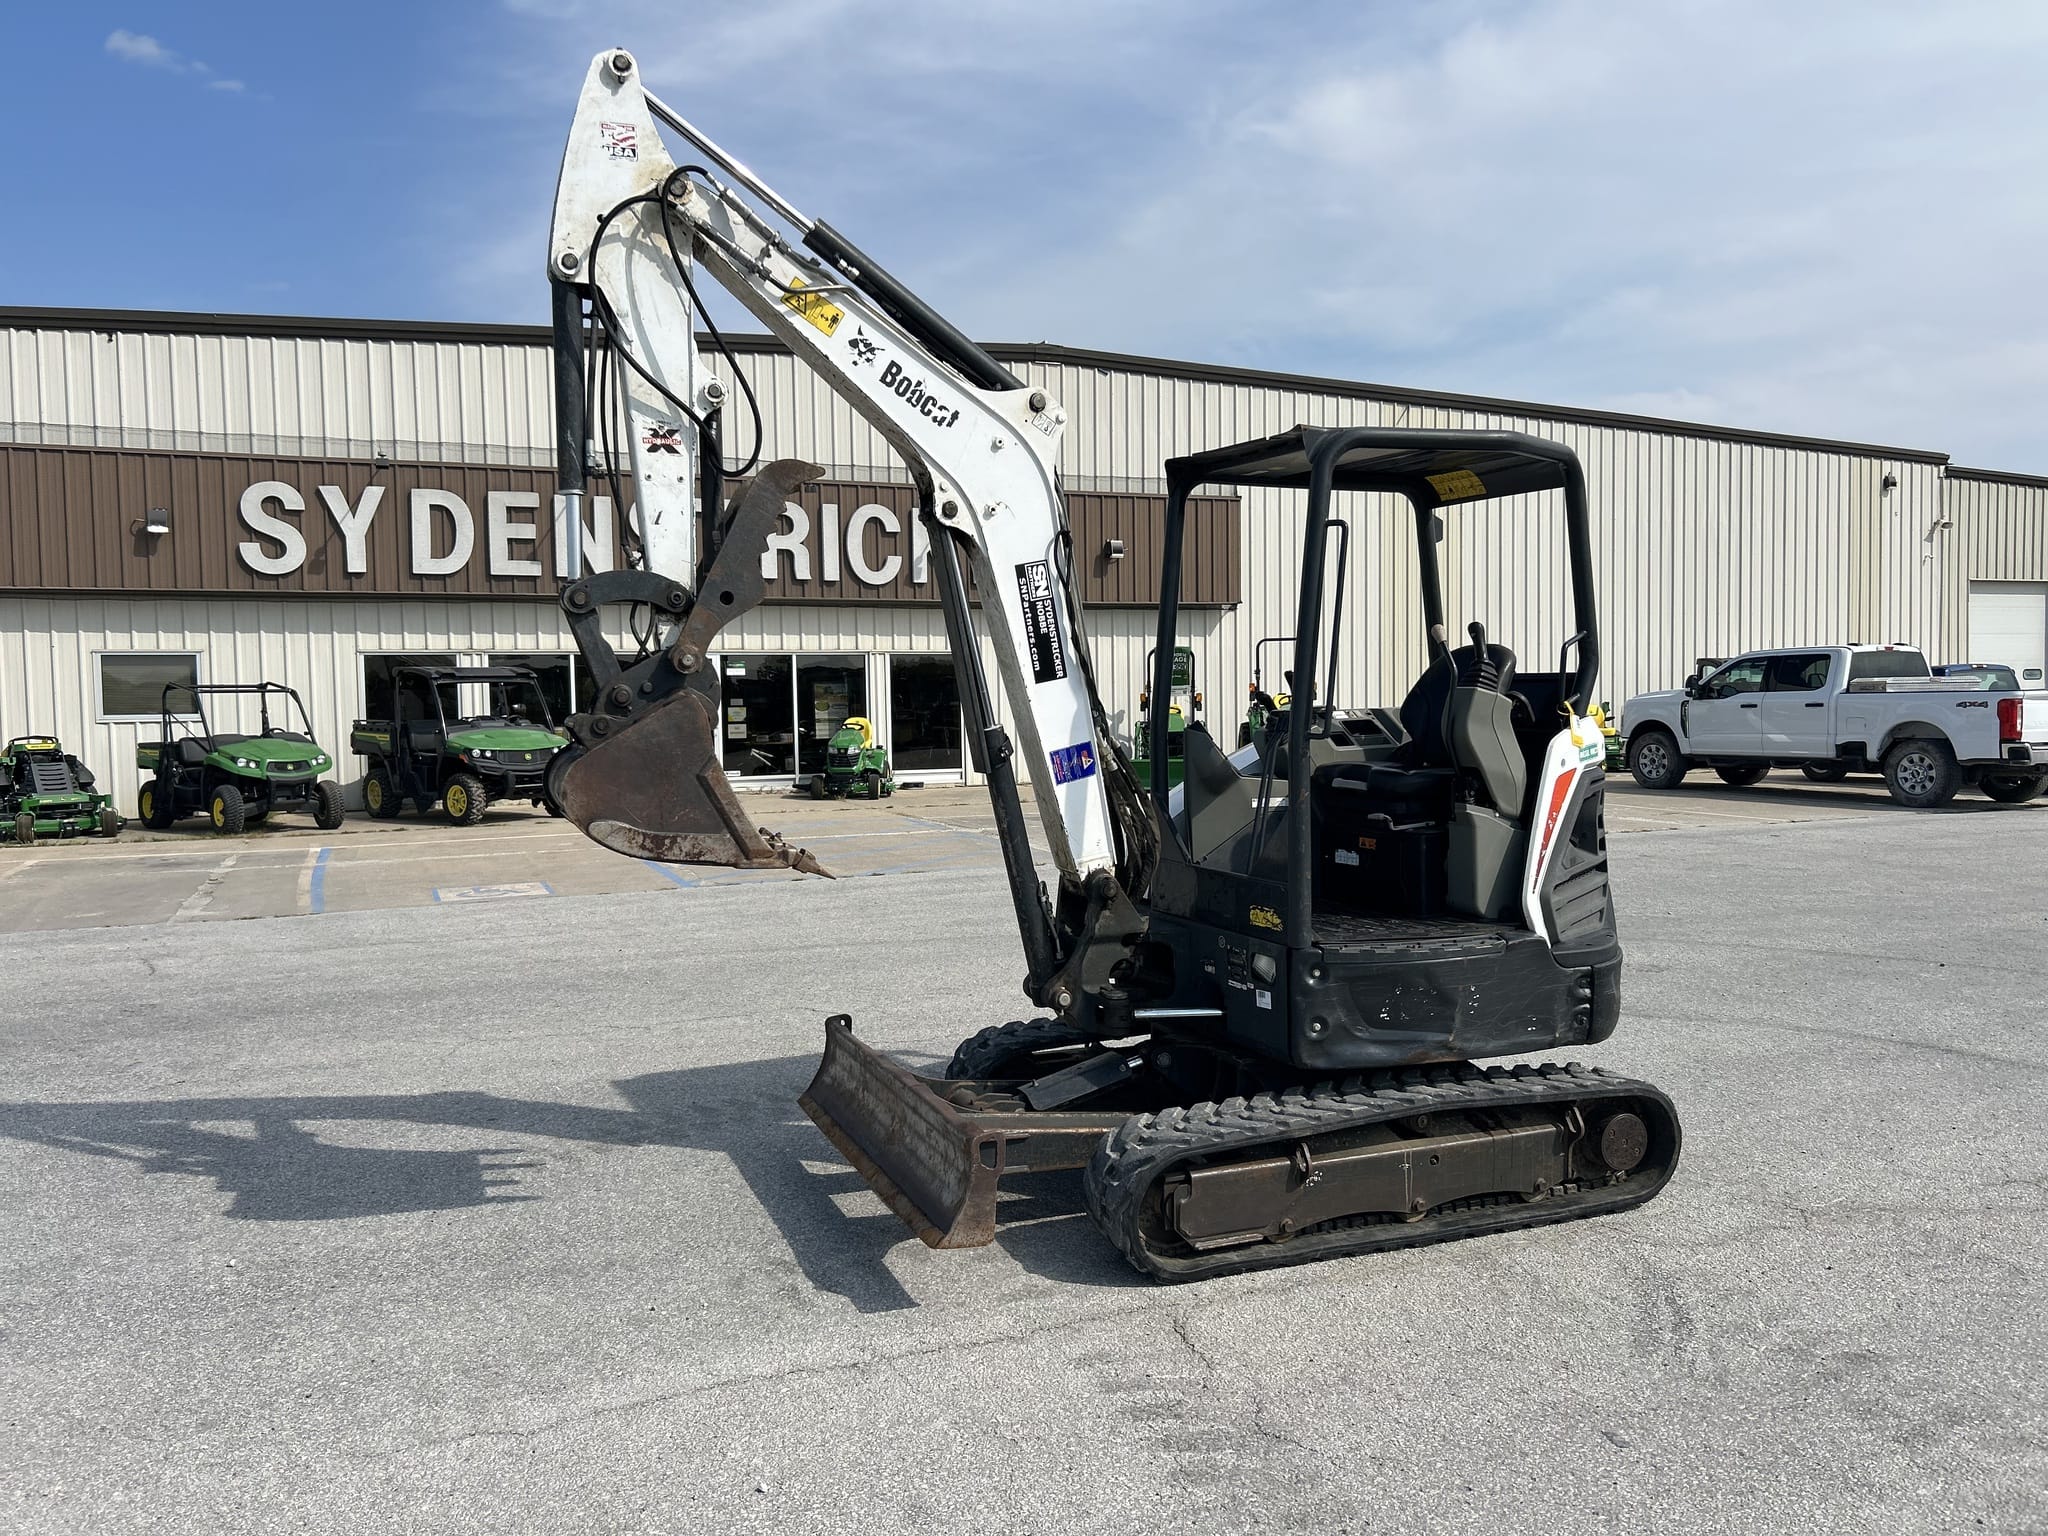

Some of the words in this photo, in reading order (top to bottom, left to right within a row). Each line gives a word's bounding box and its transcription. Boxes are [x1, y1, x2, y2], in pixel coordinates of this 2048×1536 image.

[879, 360, 960, 428] Bobcat
[643, 437, 681, 446] HYDAULIC
[1019, 577, 1040, 671] SNPartners.com
[1036, 600, 1048, 635] NOBBE
[1044, 599, 1064, 679] SYDENSTRICKER
